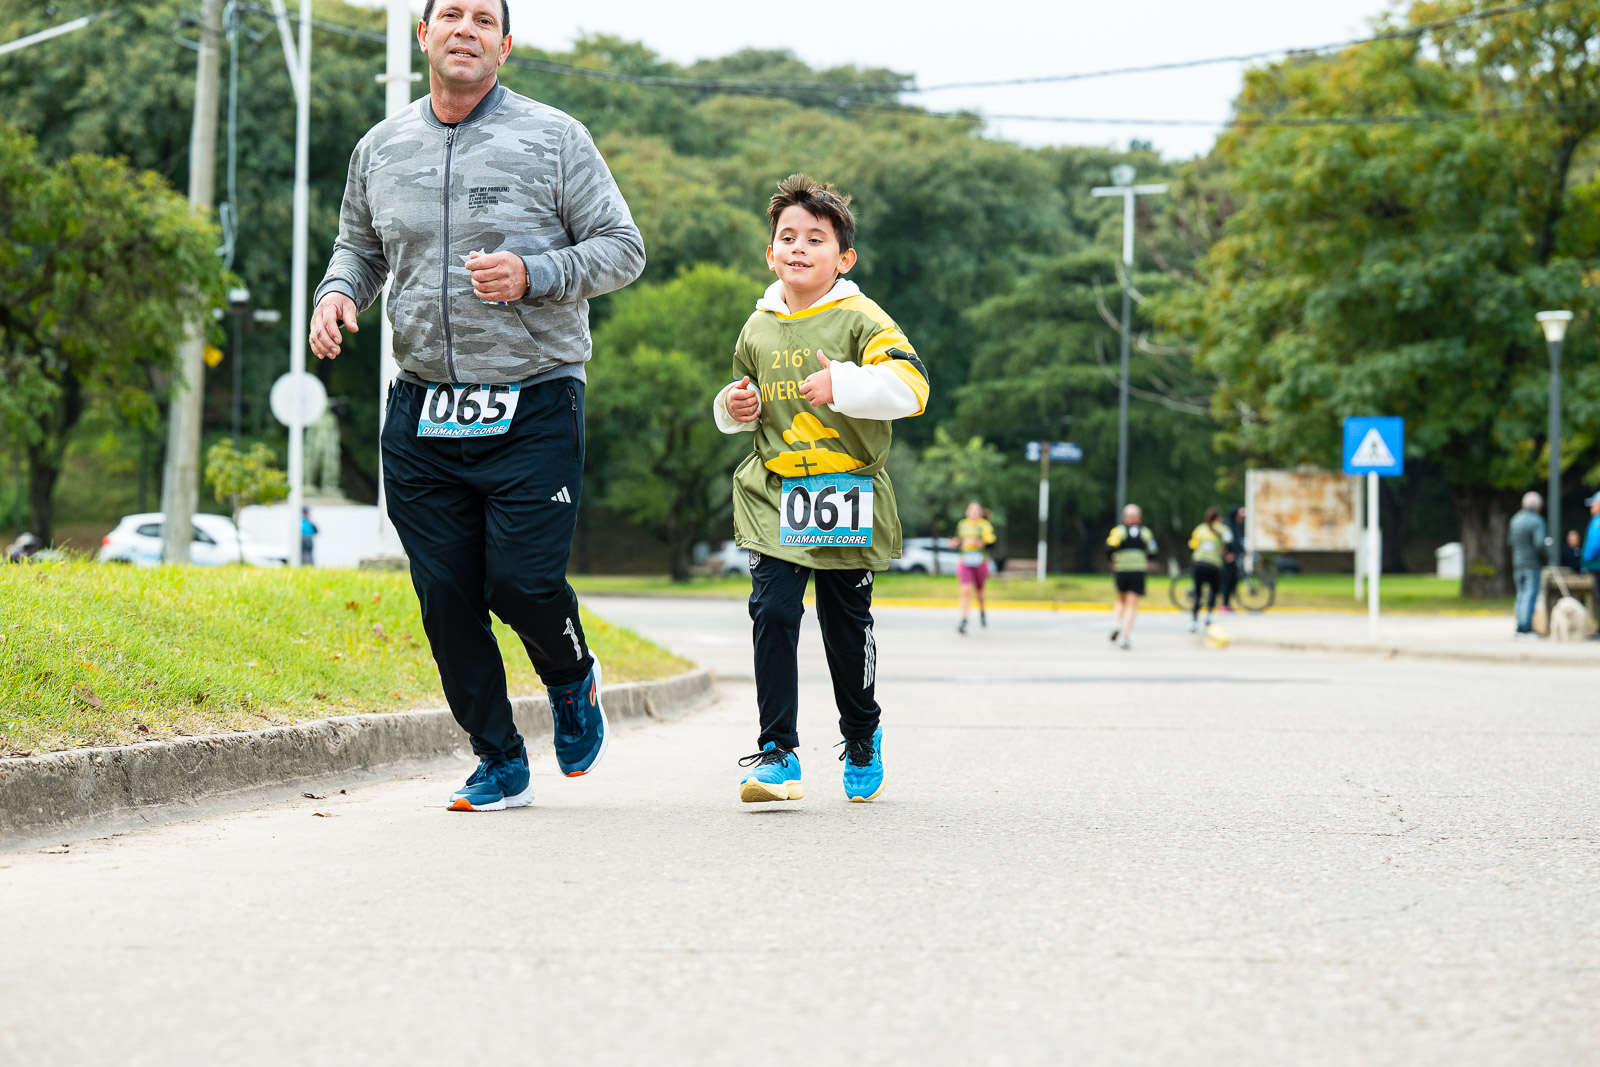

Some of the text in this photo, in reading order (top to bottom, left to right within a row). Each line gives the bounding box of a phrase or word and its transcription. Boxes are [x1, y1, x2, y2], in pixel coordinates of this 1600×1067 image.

[771, 348, 810, 369] 216°
[429, 383, 510, 425] 065
[422, 425, 505, 436] DIAMANTE CORRE
[787, 485, 859, 531] 061
[784, 535, 867, 544] DIAMANTE CORRE
